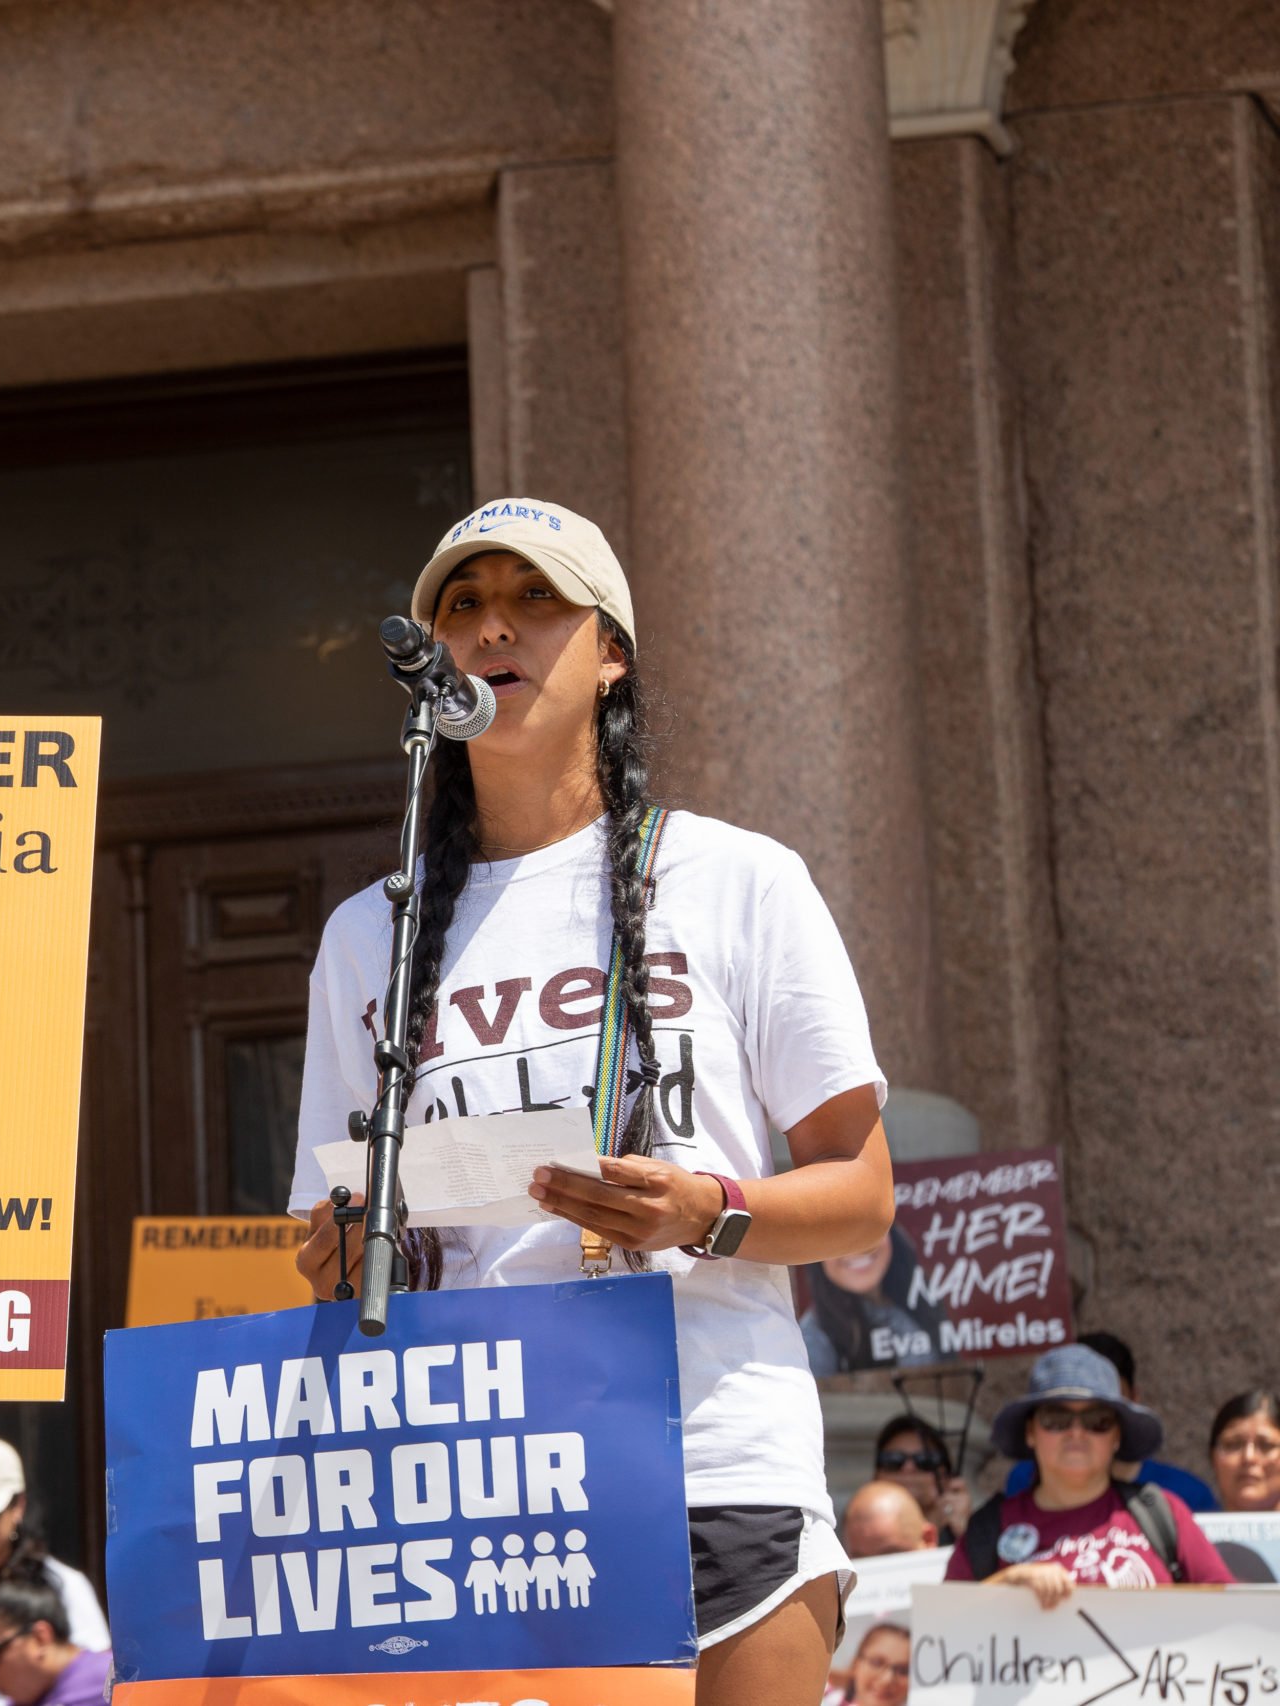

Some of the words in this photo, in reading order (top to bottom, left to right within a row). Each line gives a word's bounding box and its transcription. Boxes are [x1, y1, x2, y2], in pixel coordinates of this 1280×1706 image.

[923, 1202, 1052, 1258] HER
[907, 1248, 1055, 1309] NAME!
[870, 1327, 932, 1361] Eva
[939, 1313, 1066, 1352] Mireles
[190, 1339, 526, 1448] MARCH
[193, 1448, 378, 1543] FOR
[391, 1432, 589, 1525] OUR
[198, 1537, 457, 1641] LIVES
[913, 1633, 1087, 1688] Children
